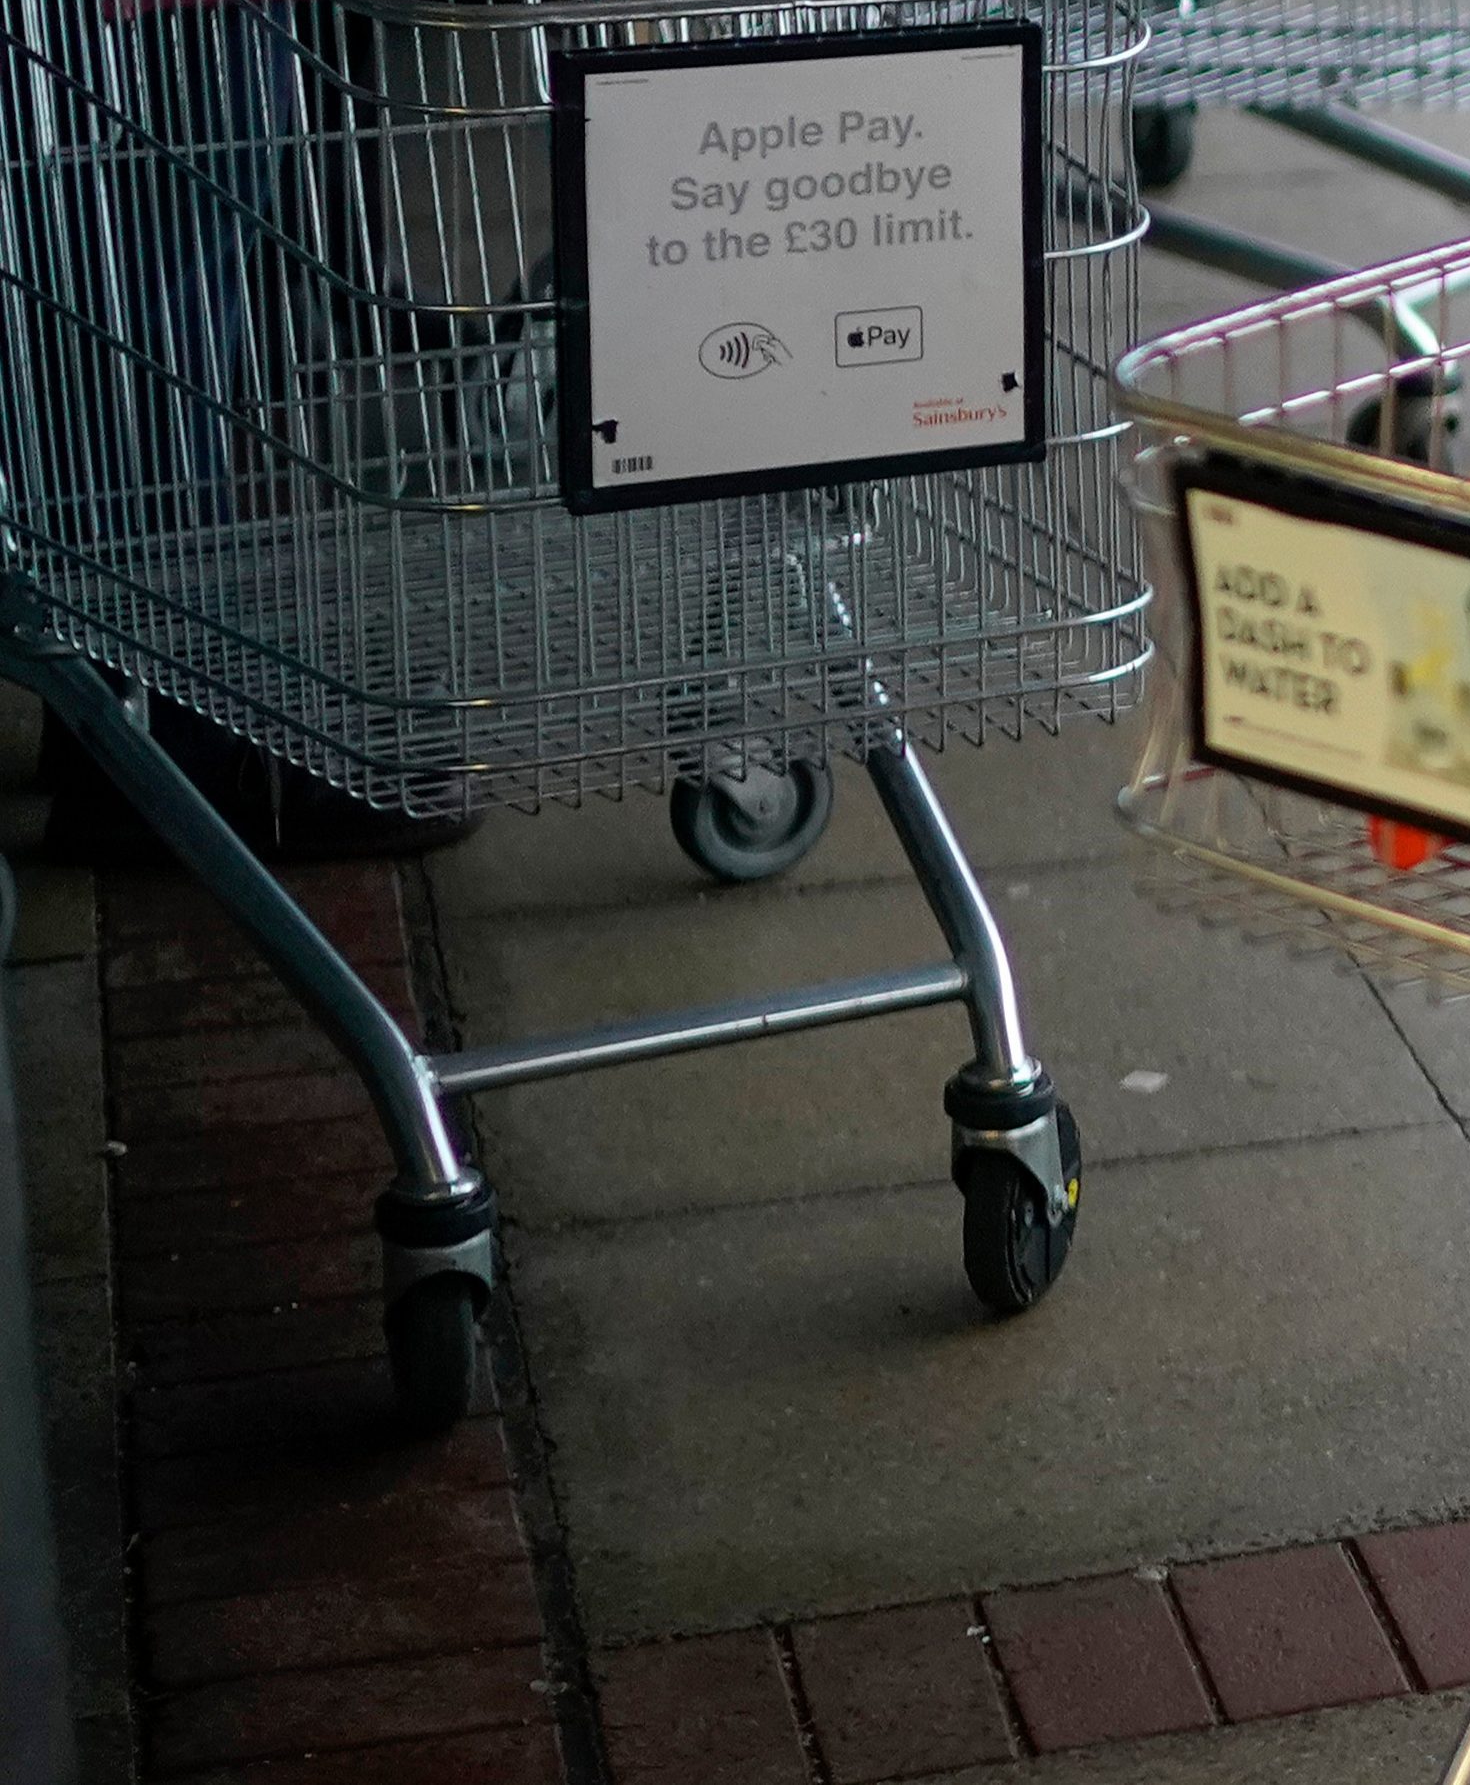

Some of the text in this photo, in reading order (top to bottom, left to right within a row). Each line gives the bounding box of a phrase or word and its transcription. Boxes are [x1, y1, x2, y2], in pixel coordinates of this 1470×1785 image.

[700, 110, 922, 161] Apple Pay.
[671, 161, 952, 216] Say goodbye
[646, 209, 973, 267] to the £30 limit.
[868, 324, 911, 349] Pay
[1320, 632, 1373, 678] TO
